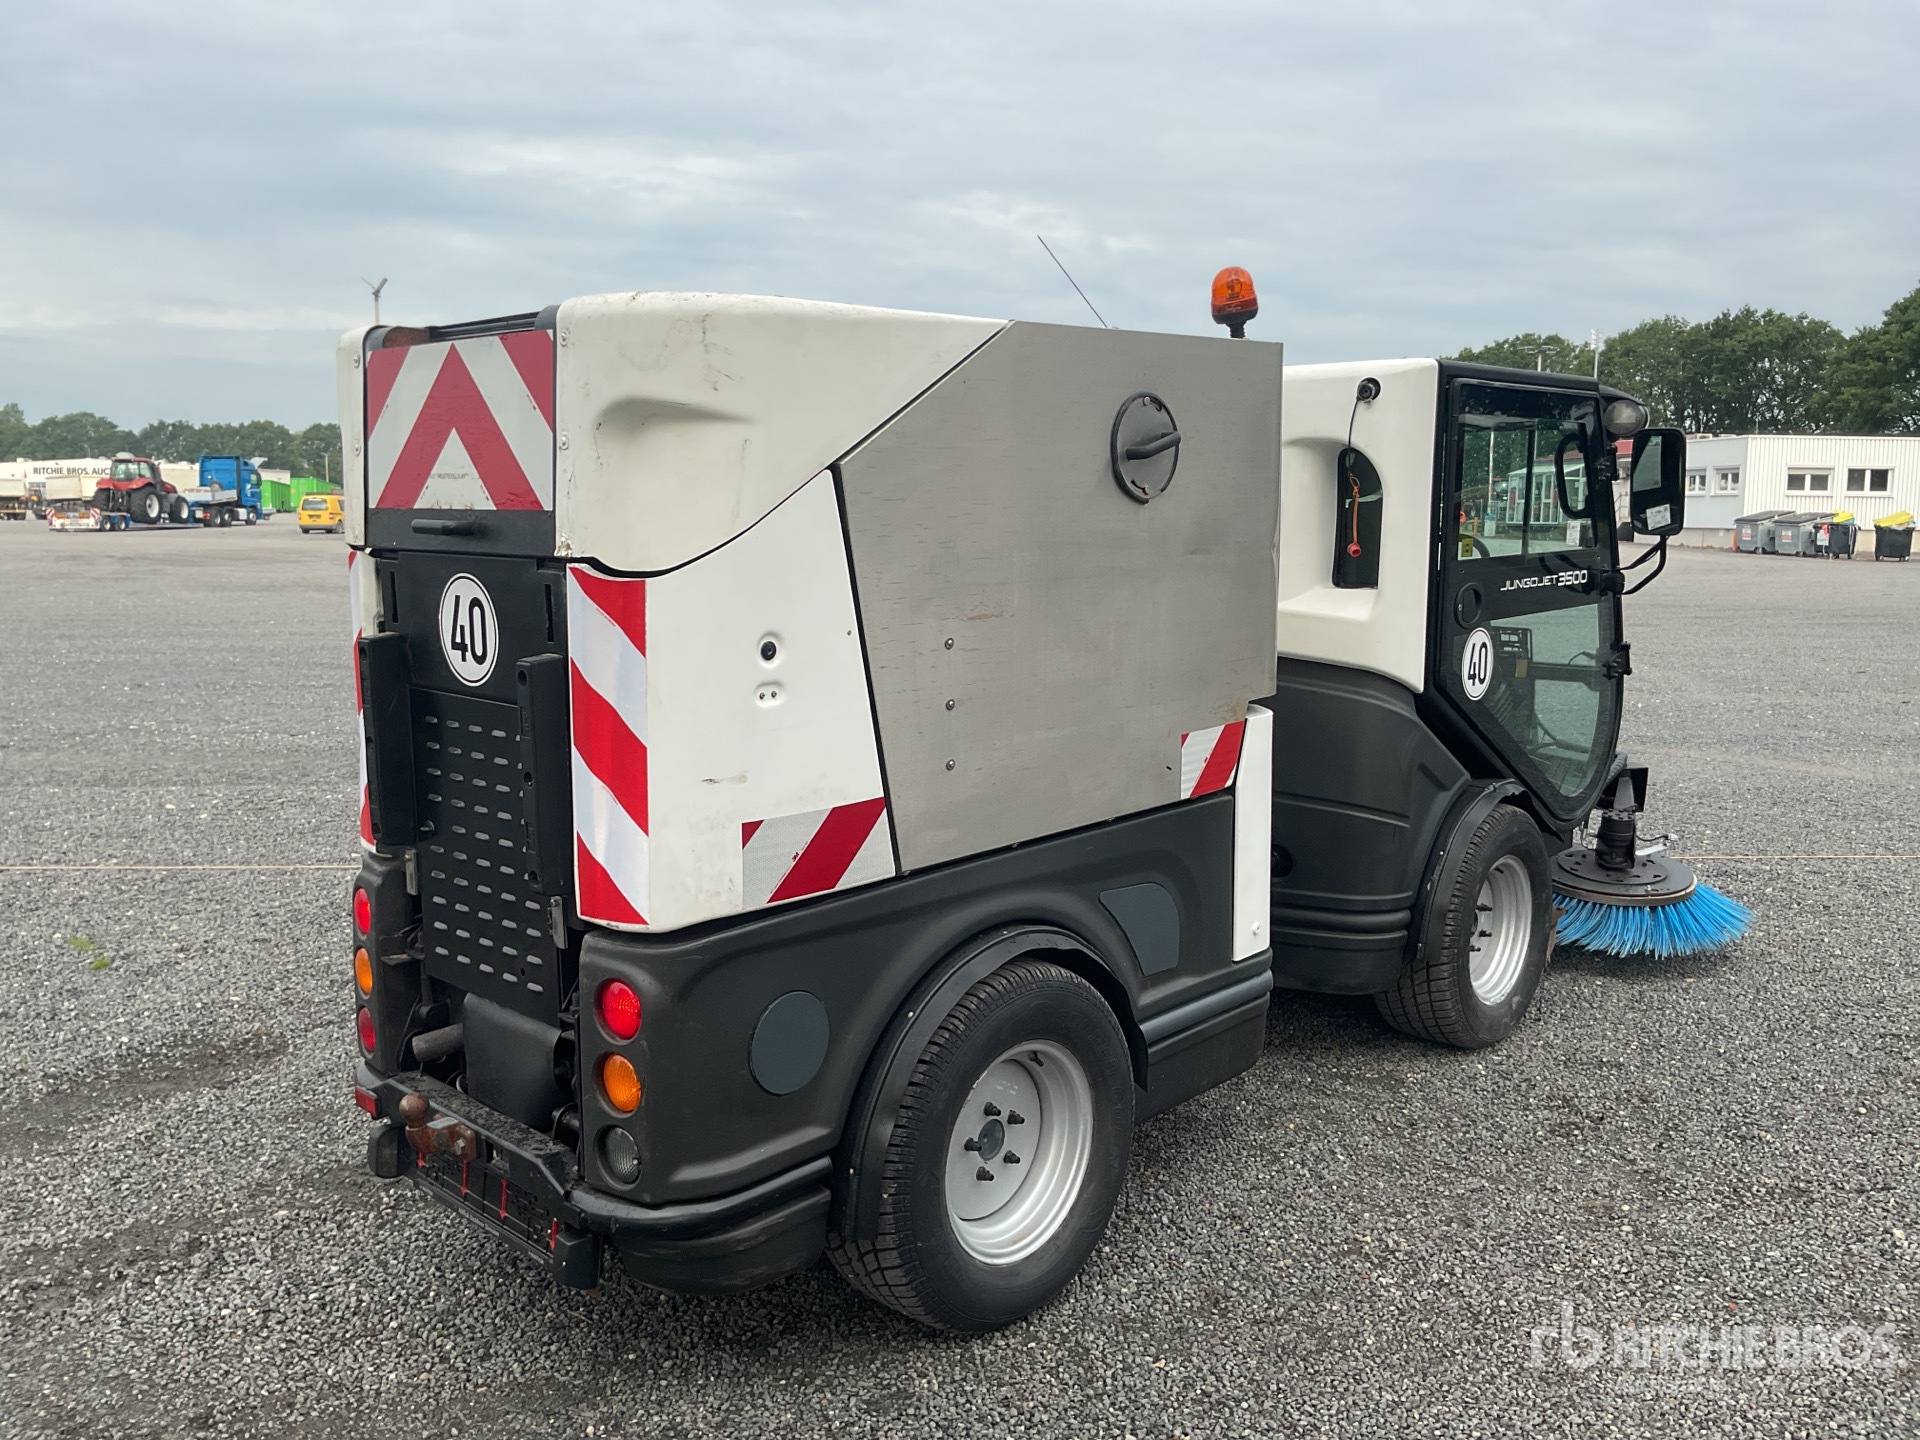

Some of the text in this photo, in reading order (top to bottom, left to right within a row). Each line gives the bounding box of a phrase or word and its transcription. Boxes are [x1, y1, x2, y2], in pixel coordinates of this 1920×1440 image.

[33, 467, 64, 475] RITCHIE
[451, 594, 488, 666] 40
[1467, 641, 1488, 687] 40
